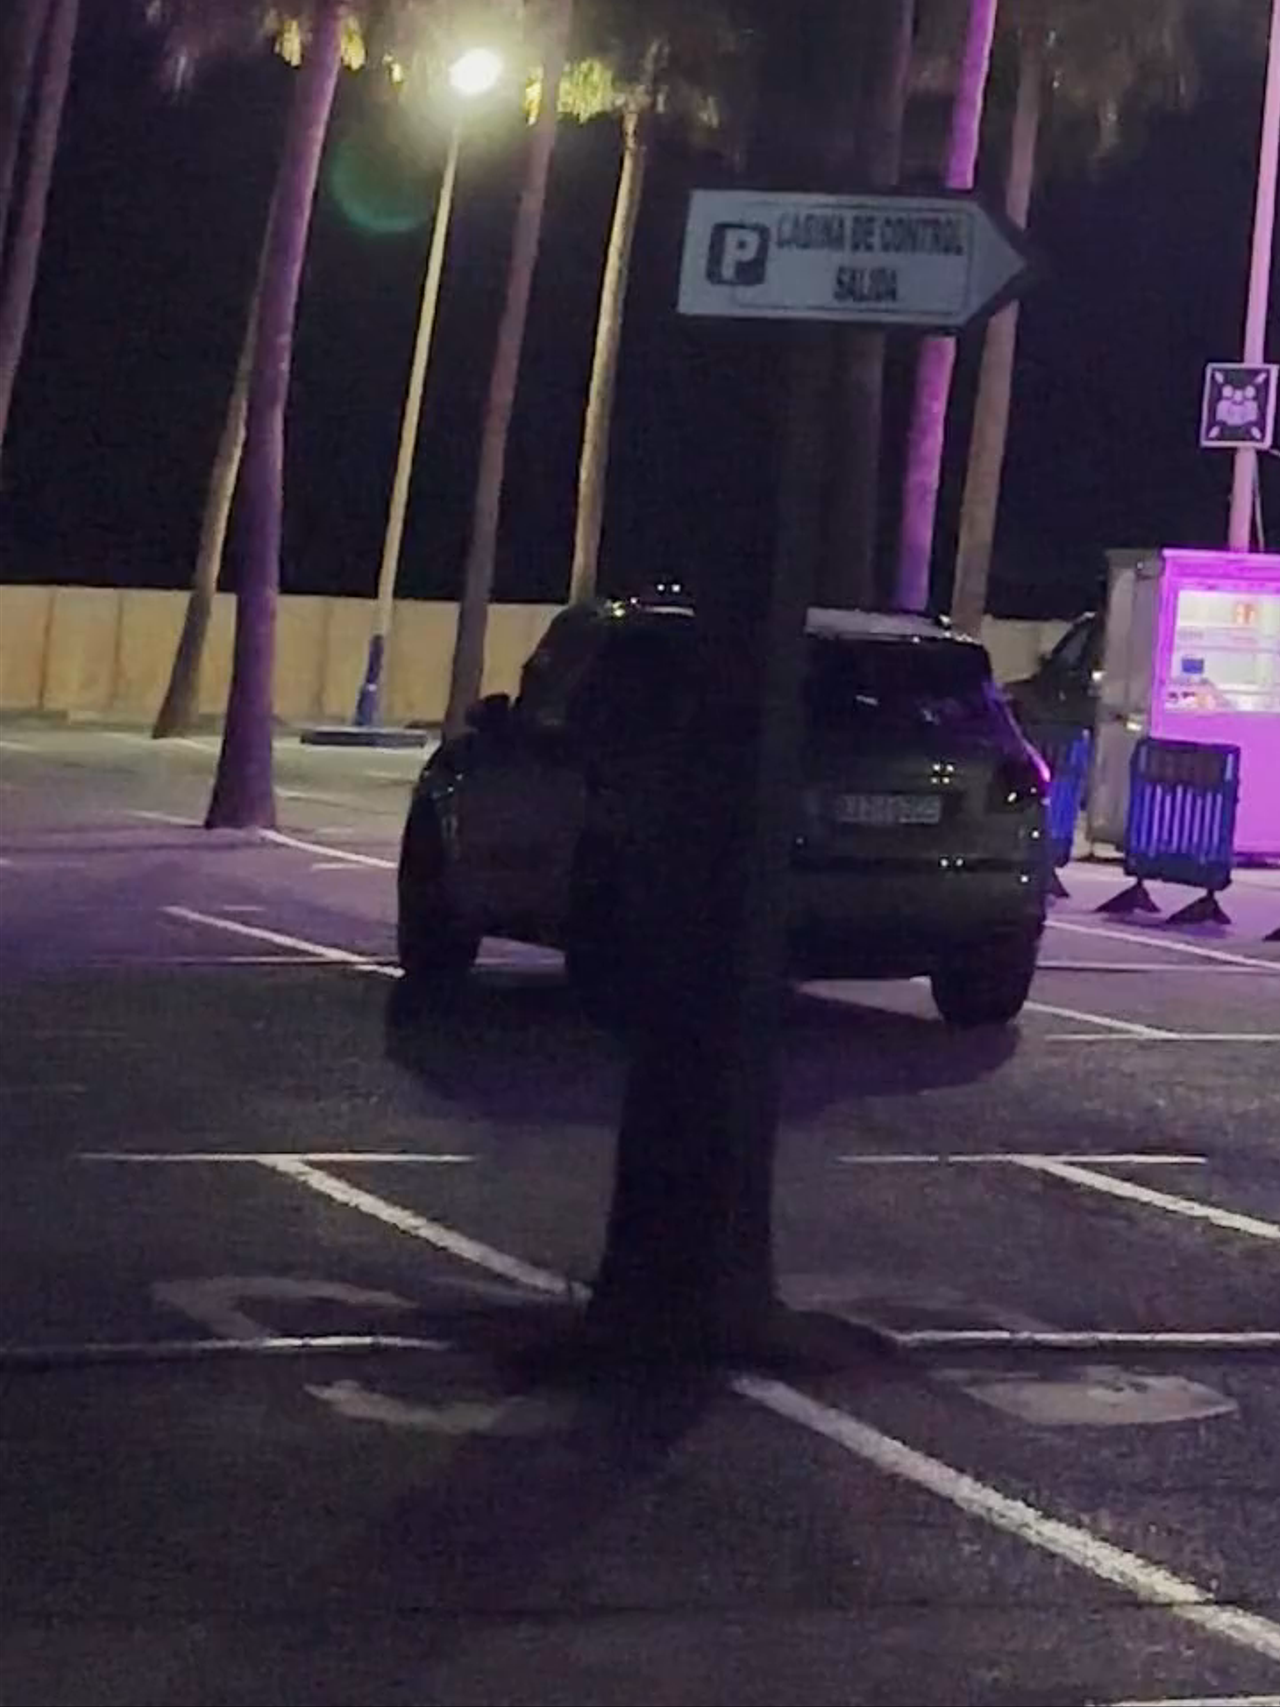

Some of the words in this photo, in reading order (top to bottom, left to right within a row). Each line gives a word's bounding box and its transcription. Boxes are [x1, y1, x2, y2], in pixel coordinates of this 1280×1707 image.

[851, 215, 876, 254] DE
[881, 217, 964, 257] CONTROL
[833, 266, 898, 302] SALIDA
